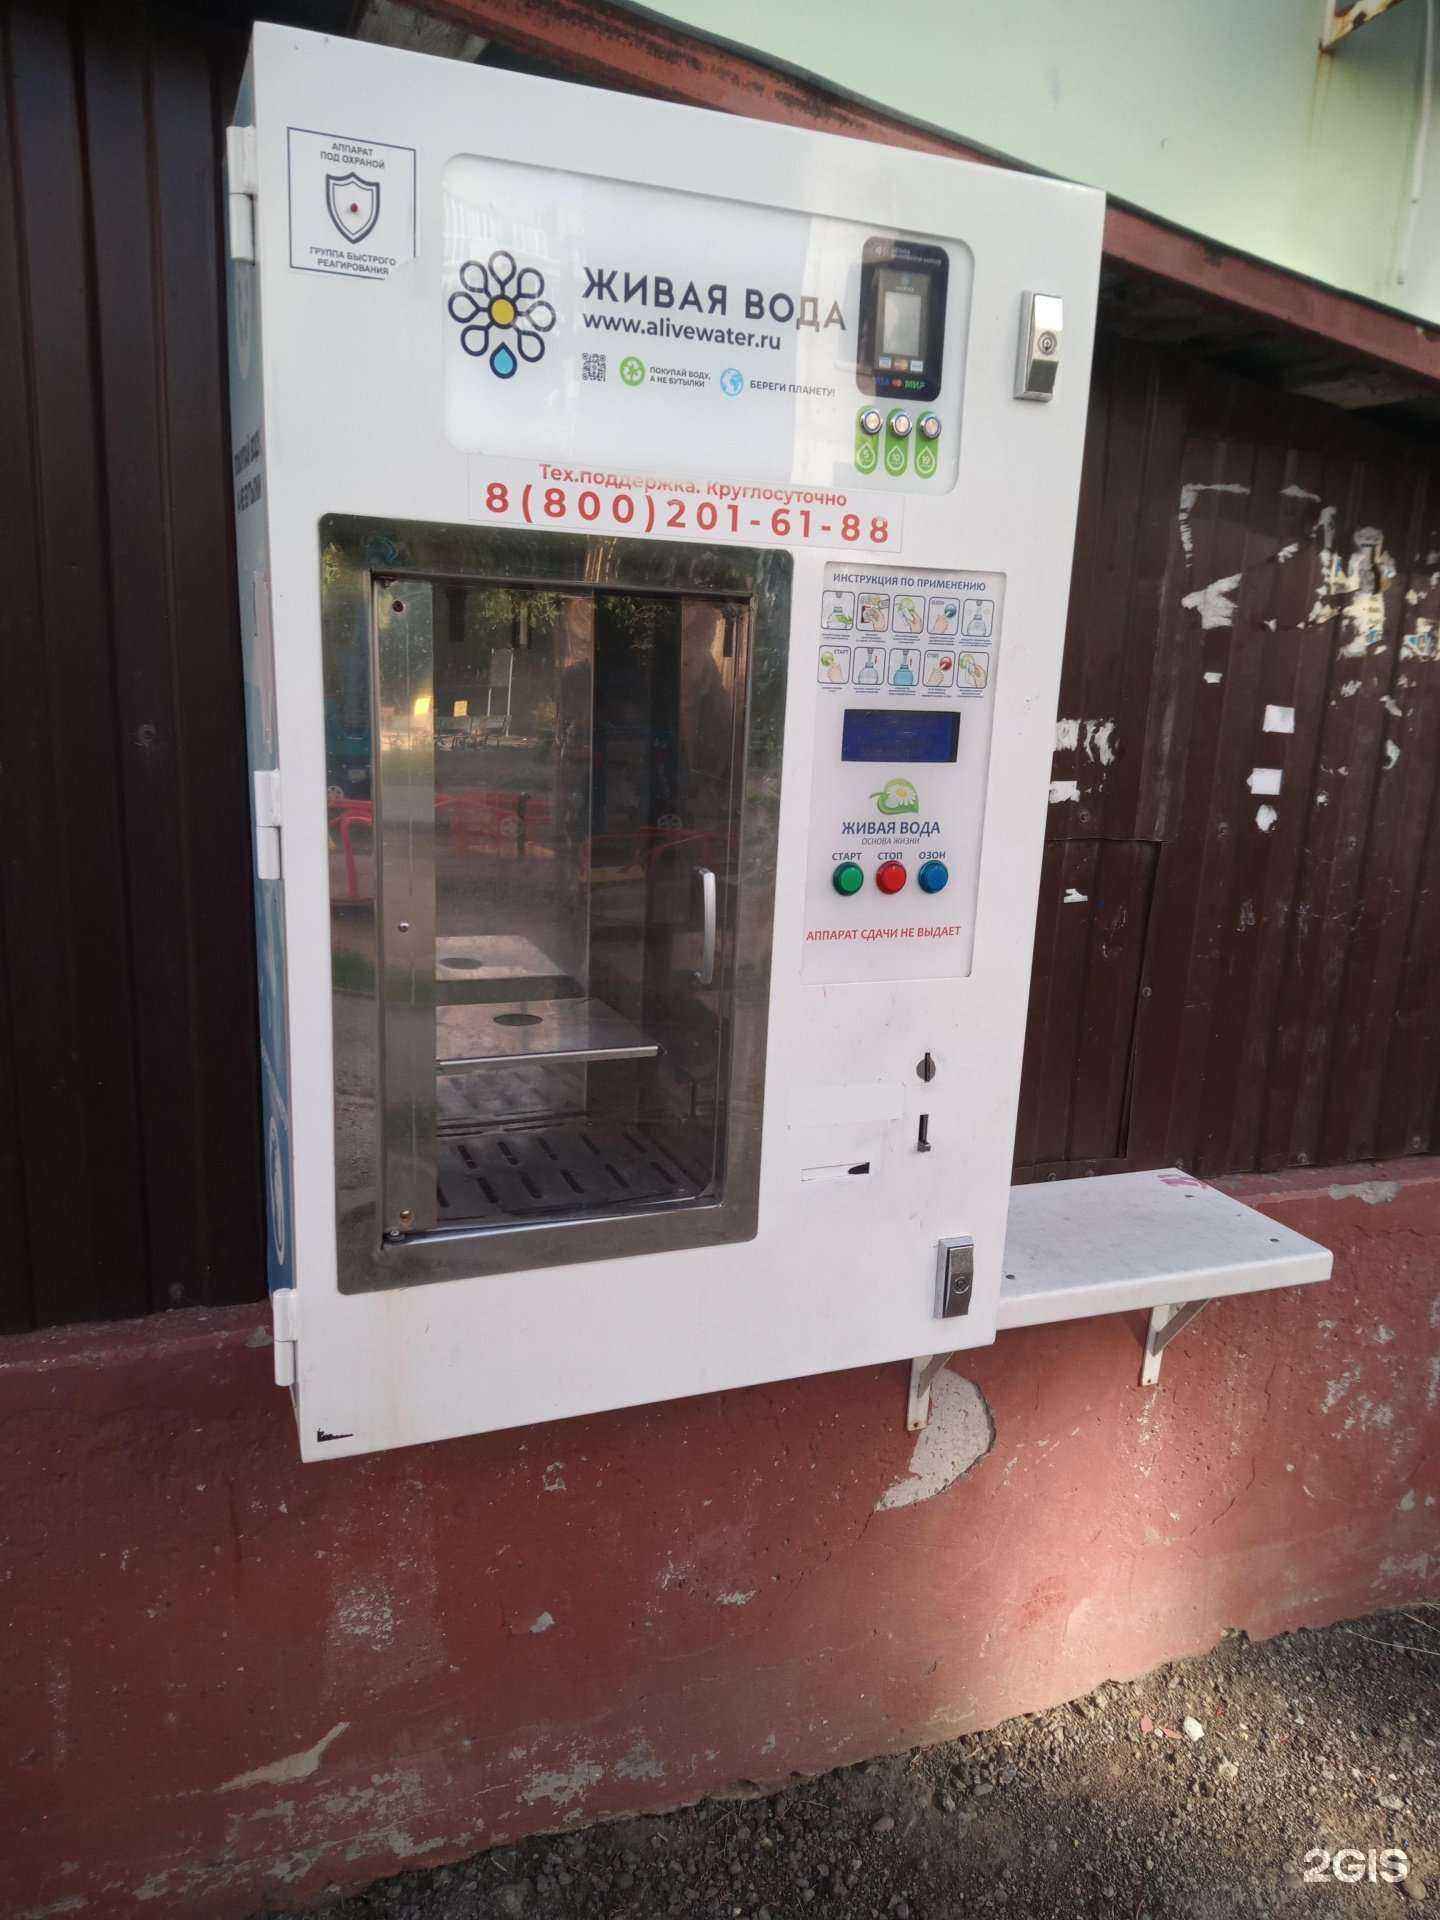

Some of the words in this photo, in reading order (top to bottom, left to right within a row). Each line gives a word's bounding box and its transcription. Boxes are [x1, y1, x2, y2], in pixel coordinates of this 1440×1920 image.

[331, 142, 374, 156] АППАРАТ
[320, 151, 340, 162] ПОД
[342, 154, 385, 169] ОХРАНОЙ
[309, 246, 345, 259] ГРУППА
[346, 251, 396, 266] БЫСТРОГО
[317, 258, 389, 275] РЕАГИРОВАНИЯ
[582, 266, 728, 316] ЖИВАЯ
[744, 288, 847, 332] ВОДА
[582, 312, 782, 350] www.alivewater.ru
[650, 366, 687, 378] ПОКУПАЙ
[657, 376, 668, 385] НЕ
[668, 377, 705, 388] БУТЫЛКИ
[749, 379, 787, 393] БЕРЕГИ
[788, 383, 836, 398] ПЛАНЕТУ!
[539, 463, 700, 495] Тех.поддержка.
[706, 480, 847, 507] Круглосуточно
[485, 481, 889, 544] 8(800)201-61-88
[833, 573, 898, 587] ИНСТРУКЦИЯ
[900, 577, 915, 587] ПО
[917, 577, 986, 591] ПРИМЕНЕНИЮ
[841, 821, 896, 835] ЖИВАЯ
[900, 821, 941, 837] ВОДА
[861, 837, 892, 845] ОСНОВА
[893, 837, 920, 845] ЖИЗНИ
[831, 852, 863, 861] СТАРТ
[877, 851, 903, 861] СТОП
[918, 851, 946, 860] ОЗОН
[806, 929, 858, 941] АППАРАТ
[860, 928, 898, 940] СДАЧИ
[900, 927, 915, 938] НЕ
[917, 926, 962, 938] ВЫДАЕТ
